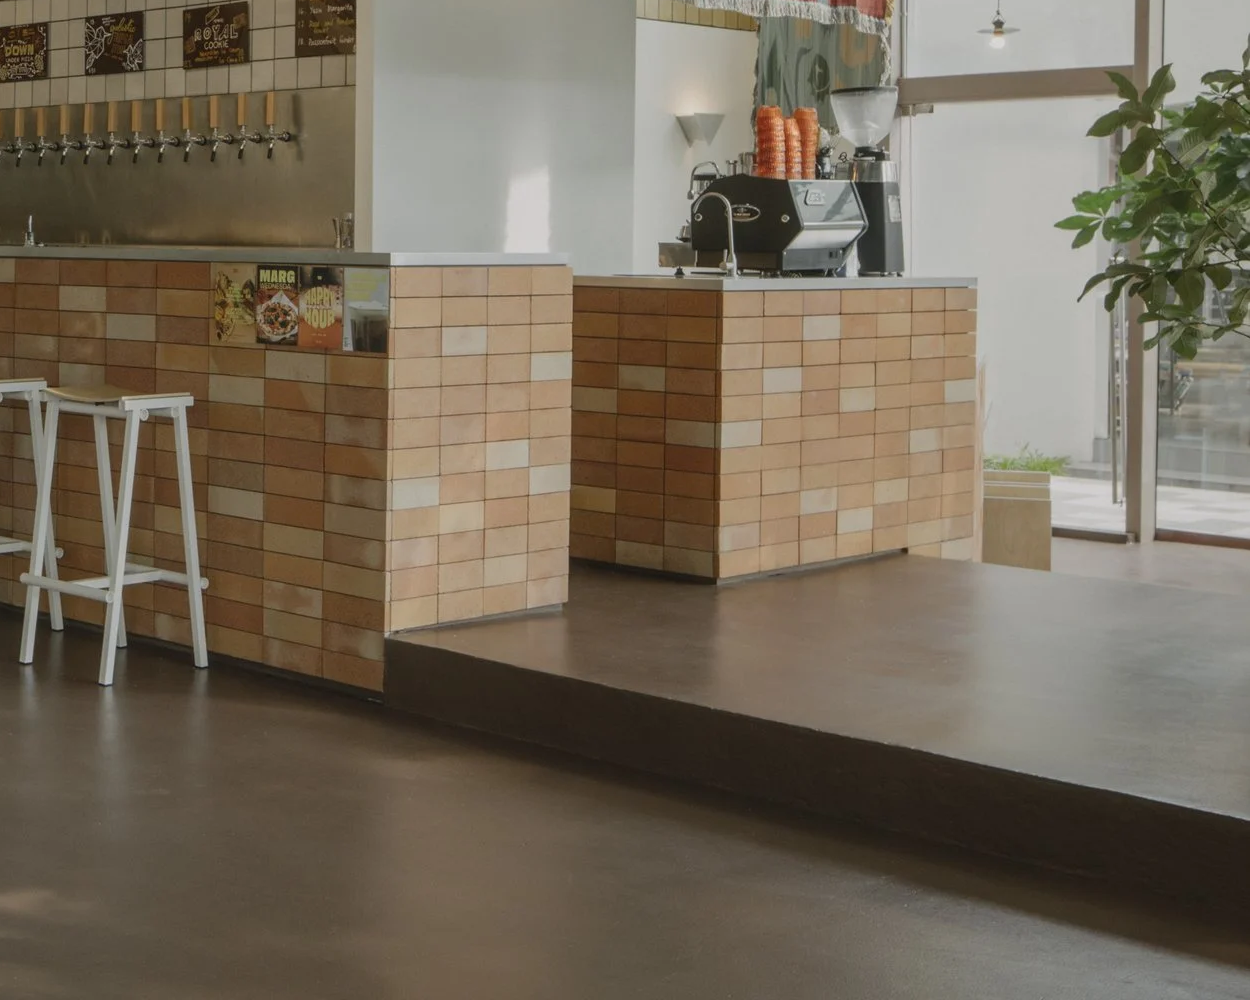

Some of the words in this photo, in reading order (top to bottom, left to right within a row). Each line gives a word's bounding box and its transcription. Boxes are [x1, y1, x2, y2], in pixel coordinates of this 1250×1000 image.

[194, 23, 239, 42] ROYAL
[204, 40, 230, 50] COOKIE
[260, 269, 296, 284] MARG
[306, 287, 335, 306] HAPPY
[304, 307, 335, 329] HOUR
